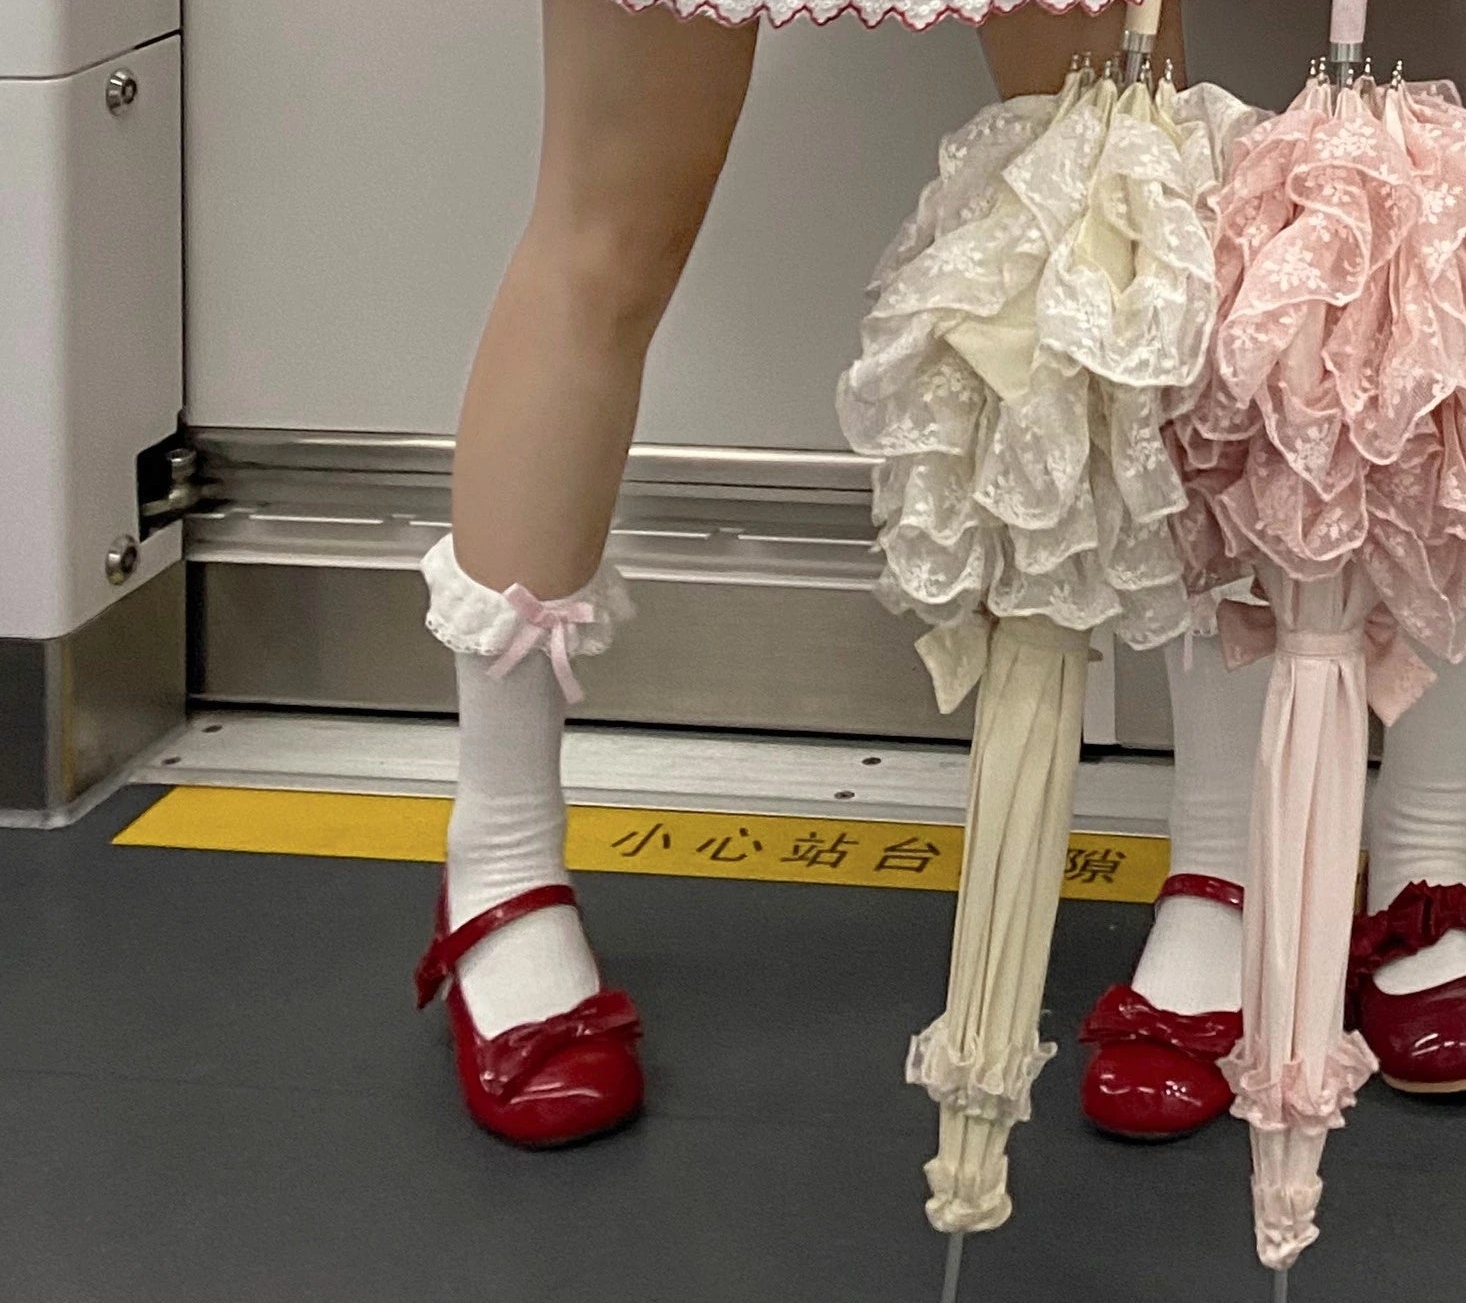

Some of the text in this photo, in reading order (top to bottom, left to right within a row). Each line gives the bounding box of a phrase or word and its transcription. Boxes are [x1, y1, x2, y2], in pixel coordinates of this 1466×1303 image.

[611, 823, 1126, 883] 小心站台隙
